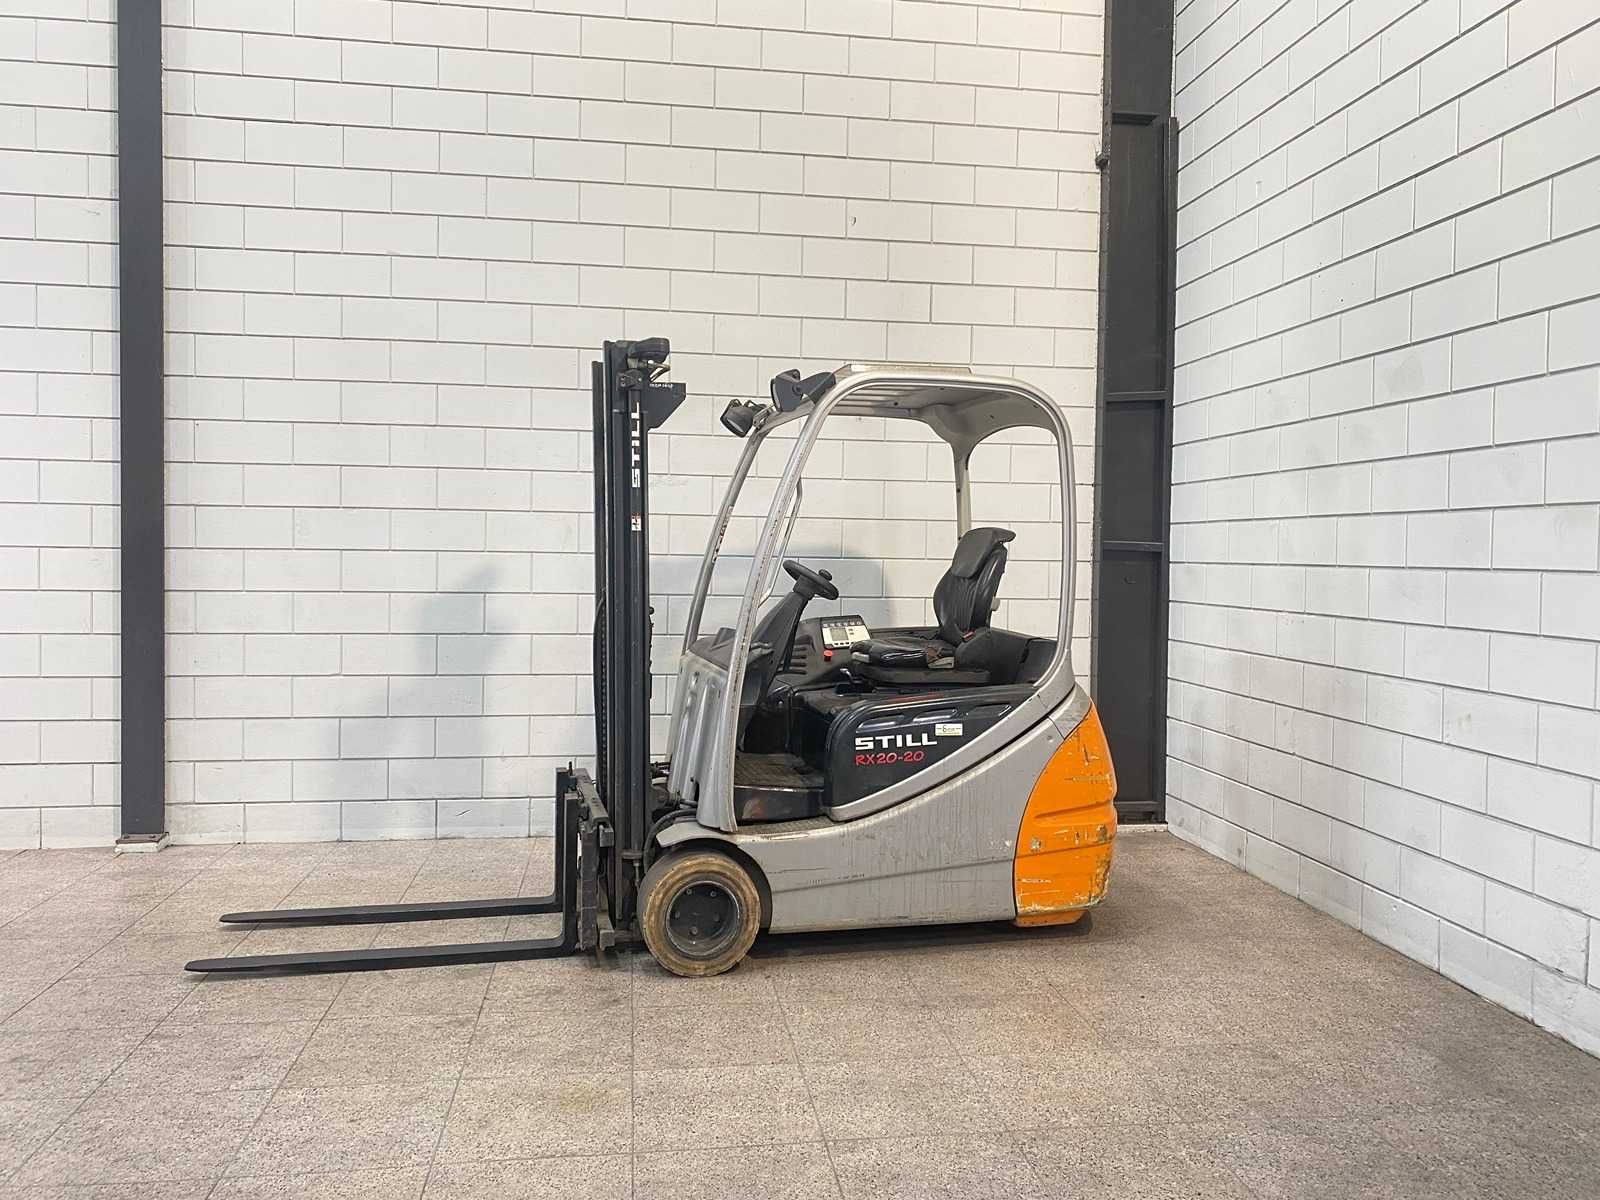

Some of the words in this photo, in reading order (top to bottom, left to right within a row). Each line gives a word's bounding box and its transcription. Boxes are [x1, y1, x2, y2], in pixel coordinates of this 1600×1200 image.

[631, 402, 640, 488] STILL
[855, 733, 937, 750] STILL
[855, 751, 924, 765] RX20-20
